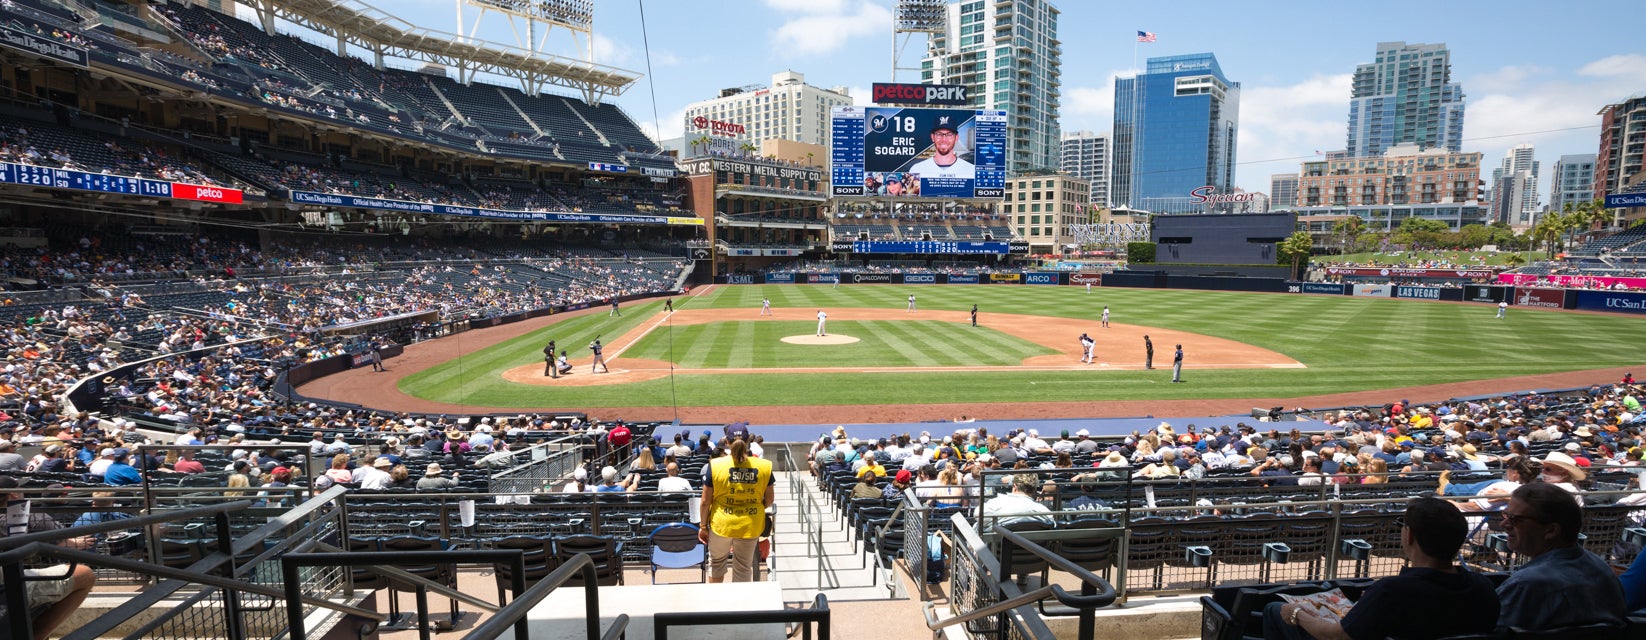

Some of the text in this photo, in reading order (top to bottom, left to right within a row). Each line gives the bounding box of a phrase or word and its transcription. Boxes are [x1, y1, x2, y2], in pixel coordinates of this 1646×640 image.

[710, 120, 746, 134] TOYOTA
[893, 116, 916, 133] 18
[708, 138, 736, 154] PADRES
[892, 137, 915, 146] ERIC
[874, 146, 916, 156] SOGARD
[699, 161, 712, 174] CO.
[713, 160, 751, 174] WESTERN
[754, 165, 779, 177] METAL
[780, 168, 807, 180] SUPPLY
[808, 172, 821, 181] CO.
[56, 170, 70, 179] MIL
[57, 180, 69, 188] SD
[130, 184, 137, 193] 3
[144, 181, 169, 194] 1:18
[196, 188, 223, 199] petco
[1190, 186, 1255, 208] Sycuan
[314, 194, 328, 204] Diego
[328, 196, 342, 204] Health
[353, 198, 368, 206] Official
[392, 202, 409, 210] Provider
[728, 275, 753, 284] ASML
[855, 275, 890, 283] QUALCOMM
[1513, 275, 1522, 284] T
[1399, 288, 1438, 298] LAS VEGAS
[1606, 298, 1620, 307] UC
[1620, 299, 1640, 308] San
[732, 472, 755, 480] 50/50
